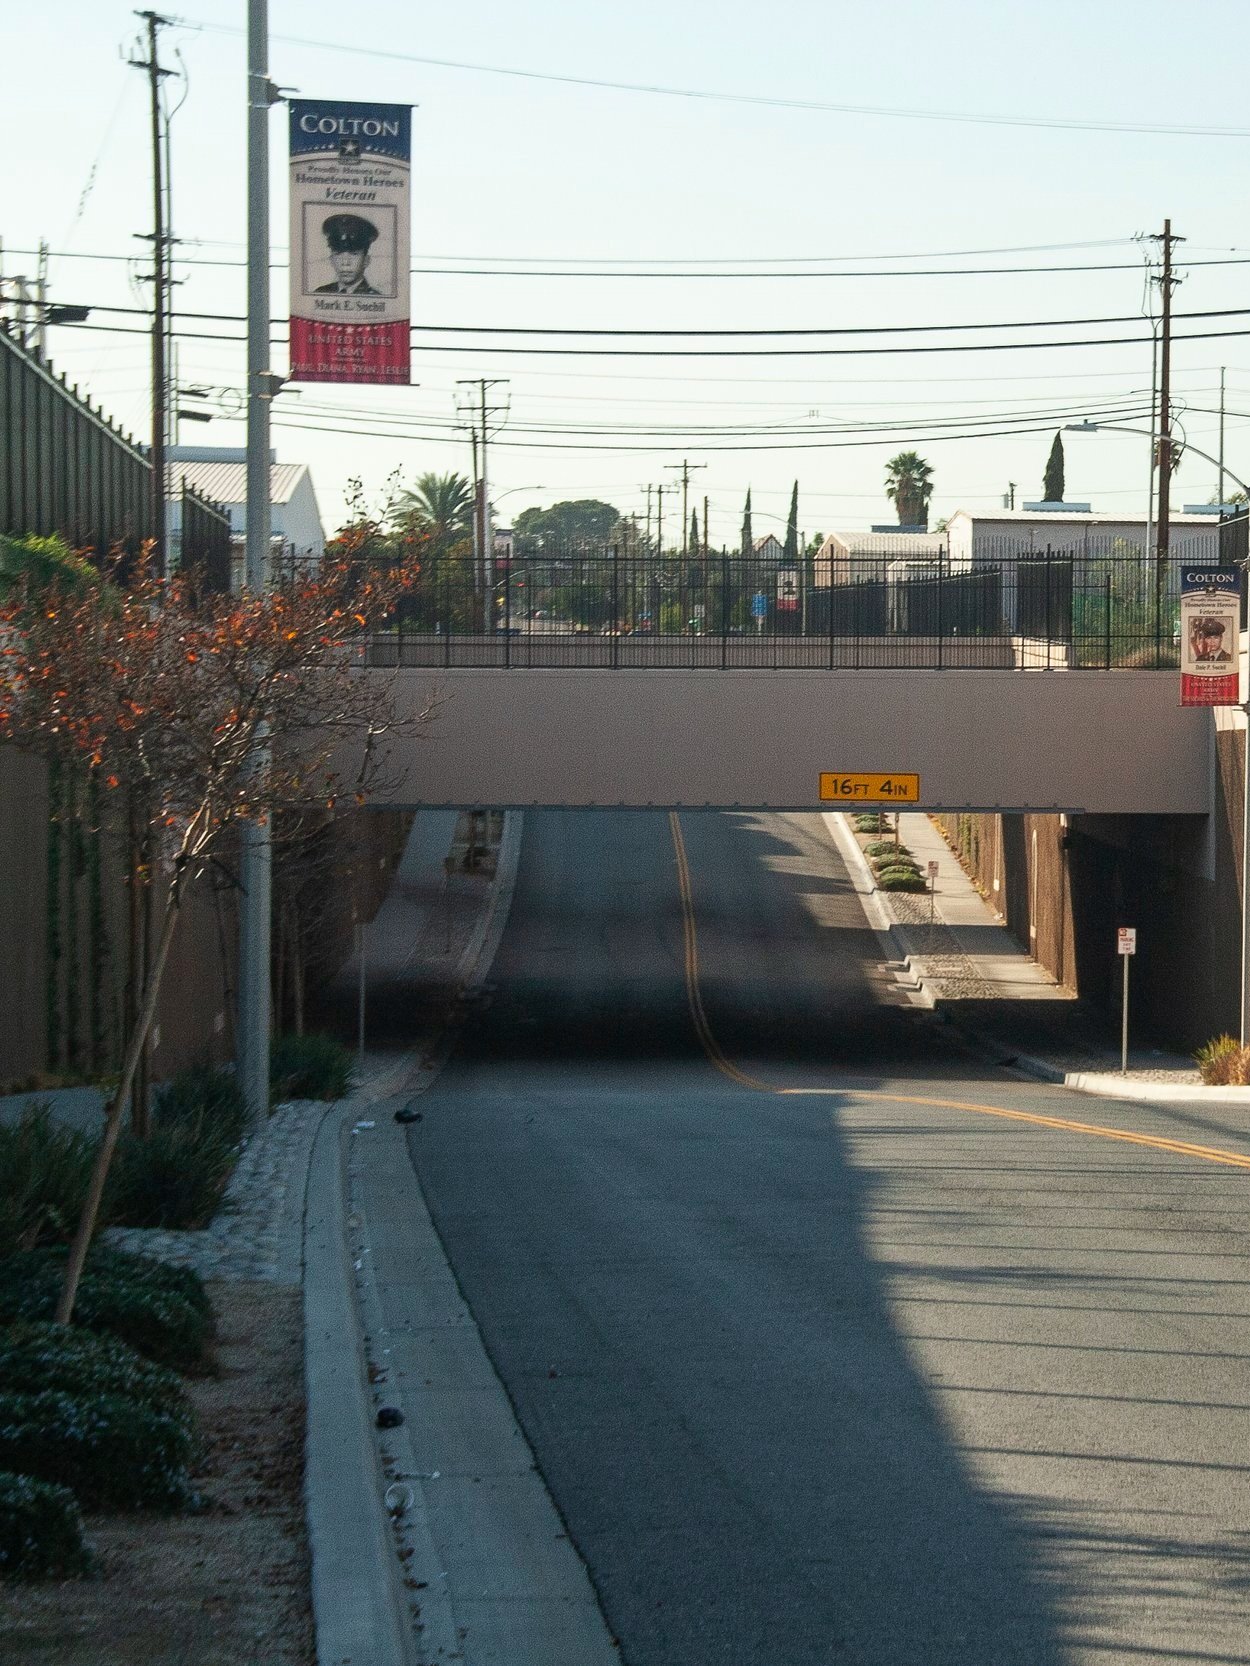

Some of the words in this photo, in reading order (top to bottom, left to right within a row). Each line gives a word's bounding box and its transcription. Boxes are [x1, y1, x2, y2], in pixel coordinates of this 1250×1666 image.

[300, 114, 400, 137] COLTON
[295, 173, 360, 186] Hometown
[362, 175, 405, 188] Heroes
[325, 187, 376, 201] Veteran
[314, 299, 340, 311] Mark
[308, 334, 353, 345] UNITED
[355, 336, 392, 346] STATES
[335, 347, 366, 357] ARMY
[1186, 572, 1235, 583] COLTON
[832, 778, 870, 796] 16FT
[879, 779, 908, 796] 4IN
